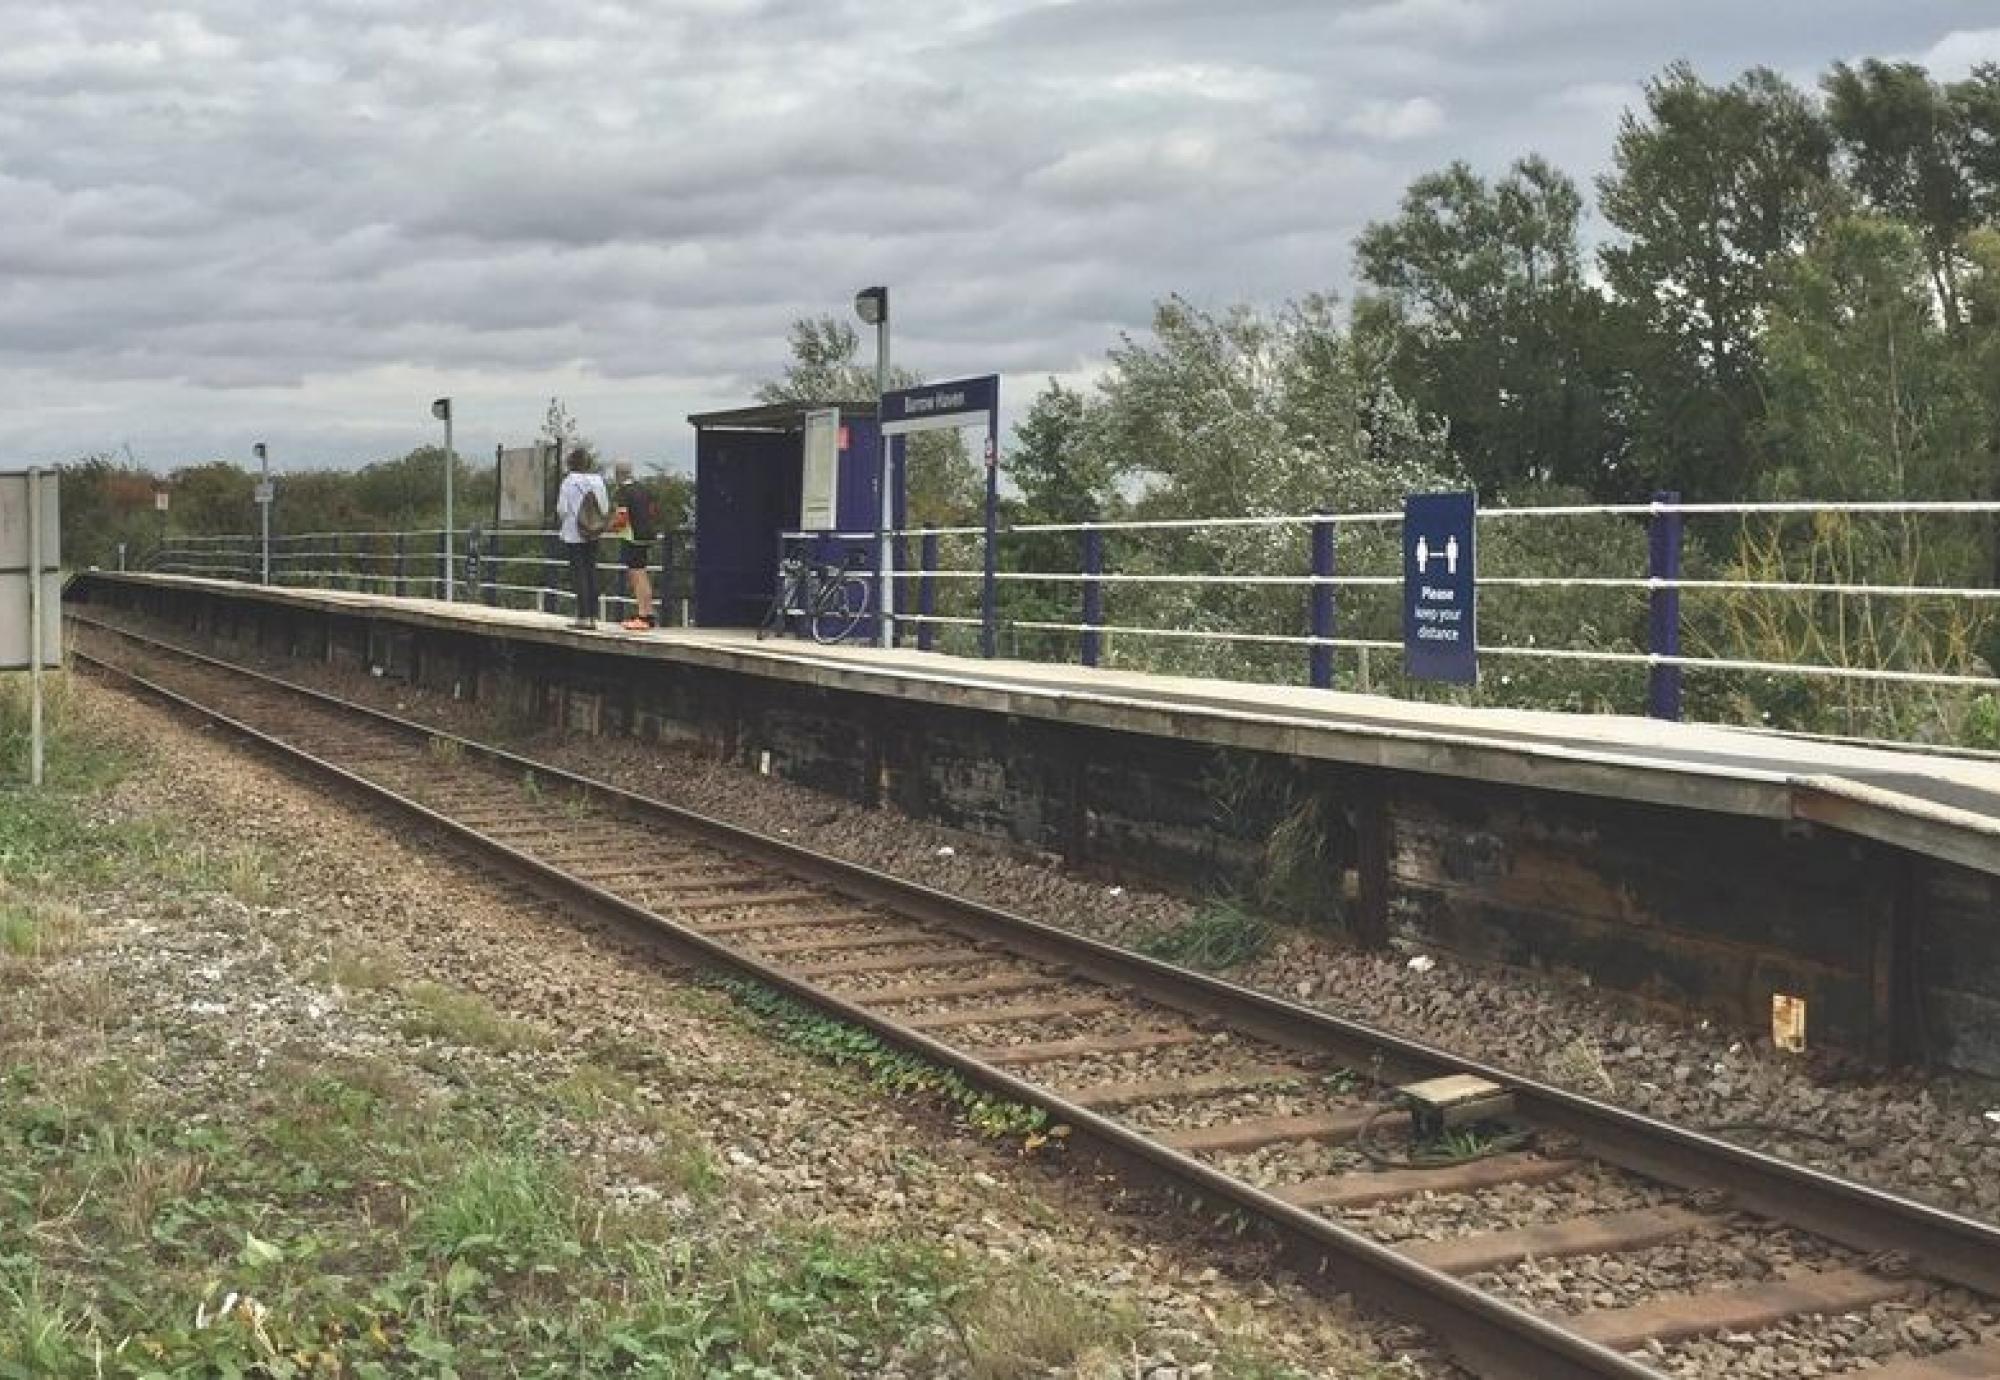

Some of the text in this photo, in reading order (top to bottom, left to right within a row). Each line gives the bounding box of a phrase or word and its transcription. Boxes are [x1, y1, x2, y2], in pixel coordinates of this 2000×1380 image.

[1422, 586, 1454, 600] Please
[1415, 606, 1462, 622] keep your
[1417, 625, 1459, 640] distance
